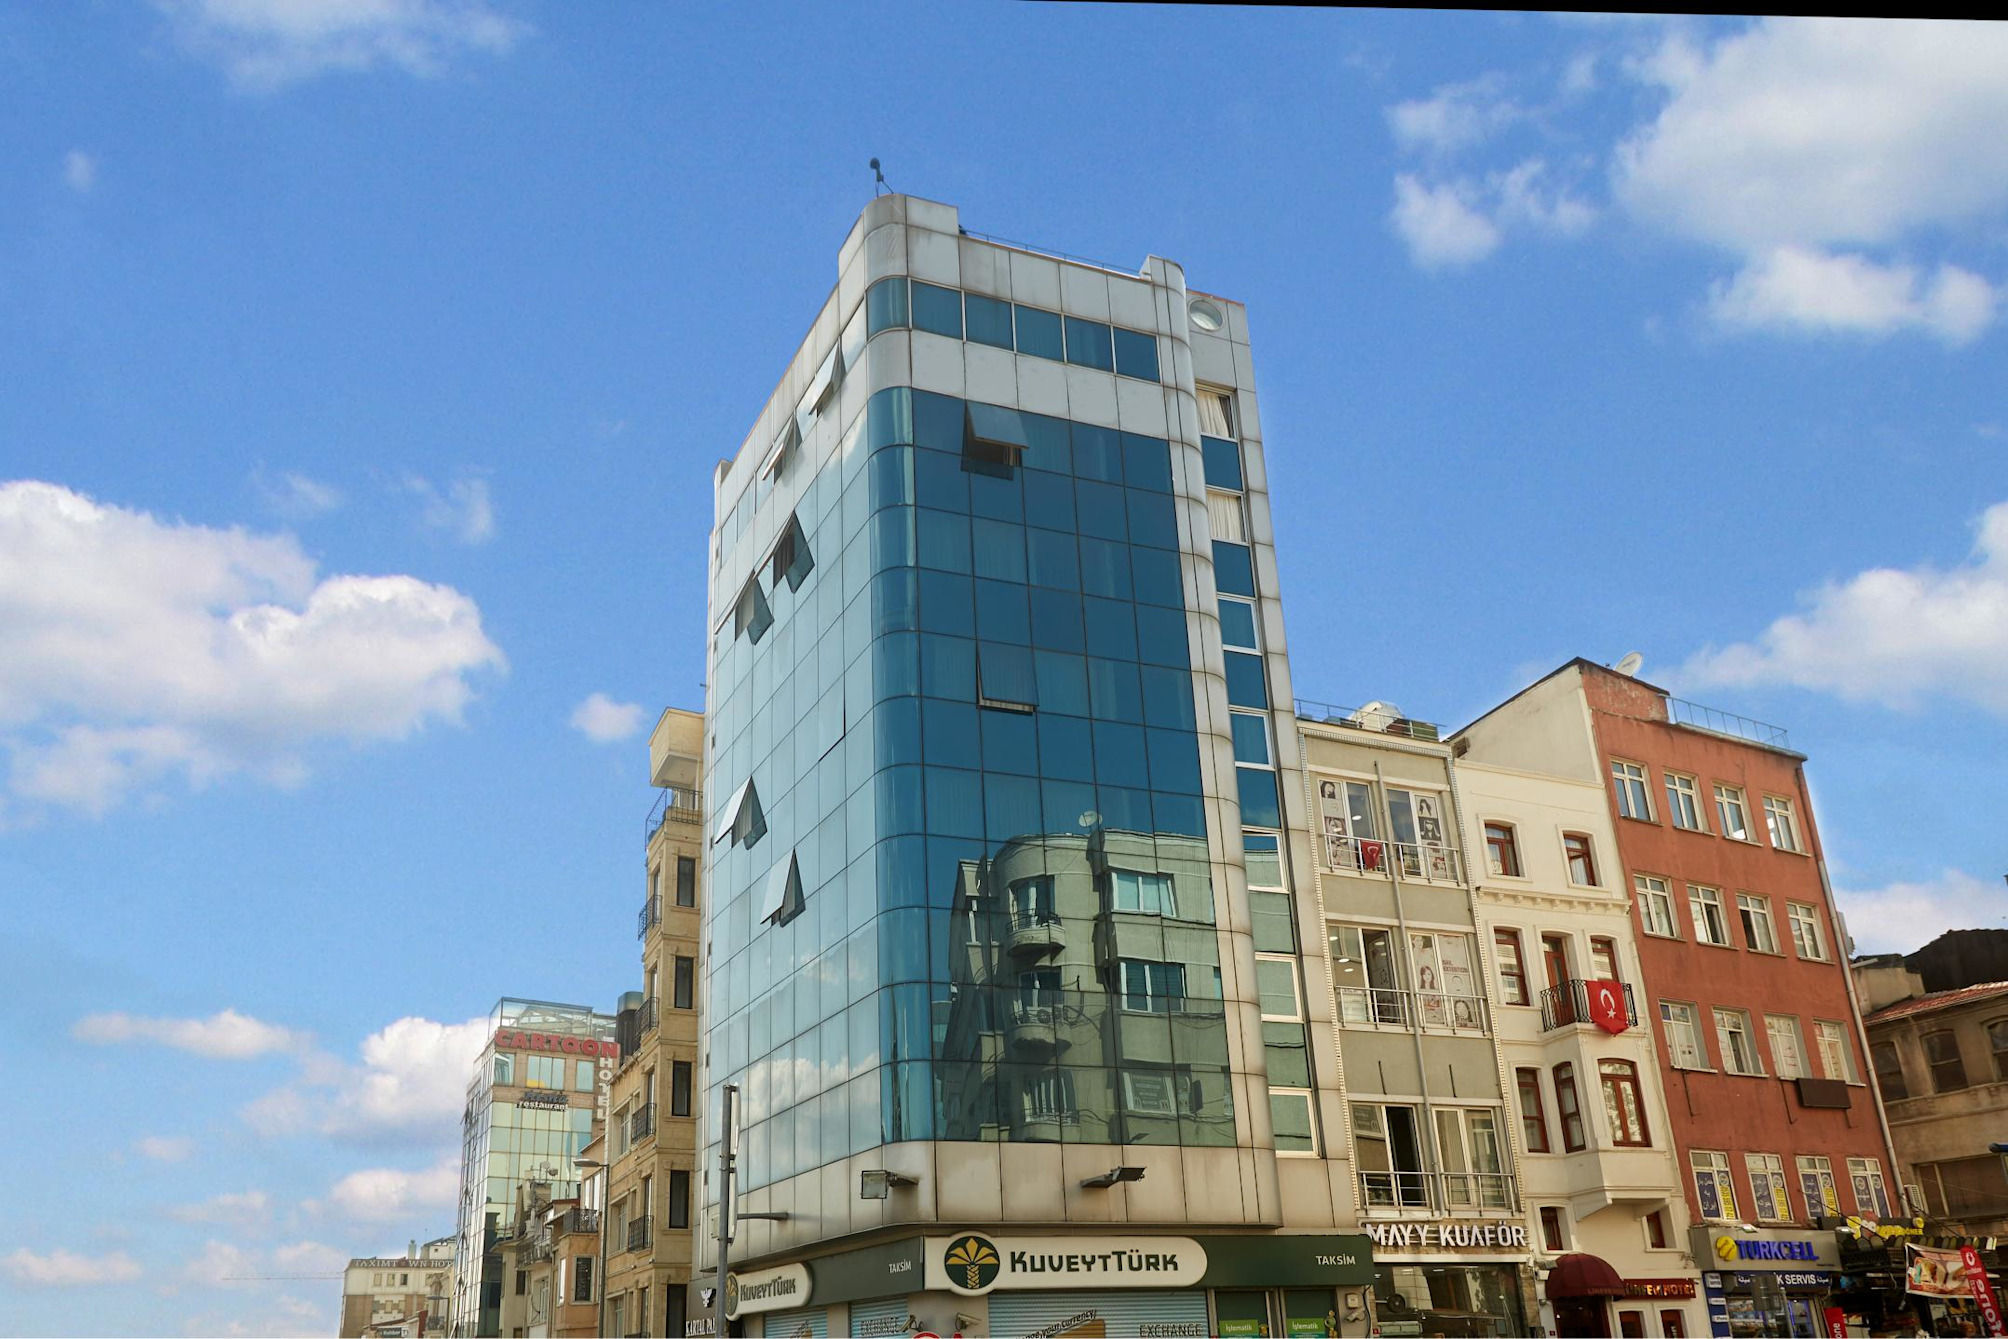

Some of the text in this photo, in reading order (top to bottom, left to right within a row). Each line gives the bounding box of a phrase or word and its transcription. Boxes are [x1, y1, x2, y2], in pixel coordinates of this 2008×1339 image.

[495, 1029, 619, 1059] CARTOON
[519, 1100, 568, 1110] restaurant
[1439, 1220, 1527, 1247] KUAFÖR
[1735, 1239, 1820, 1261] TURKCELL
[888, 1258, 912, 1274] TAKSİM
[1315, 1253, 1356, 1265] TAKSİM
[1140, 1323, 1203, 1338] EXCHANGE
